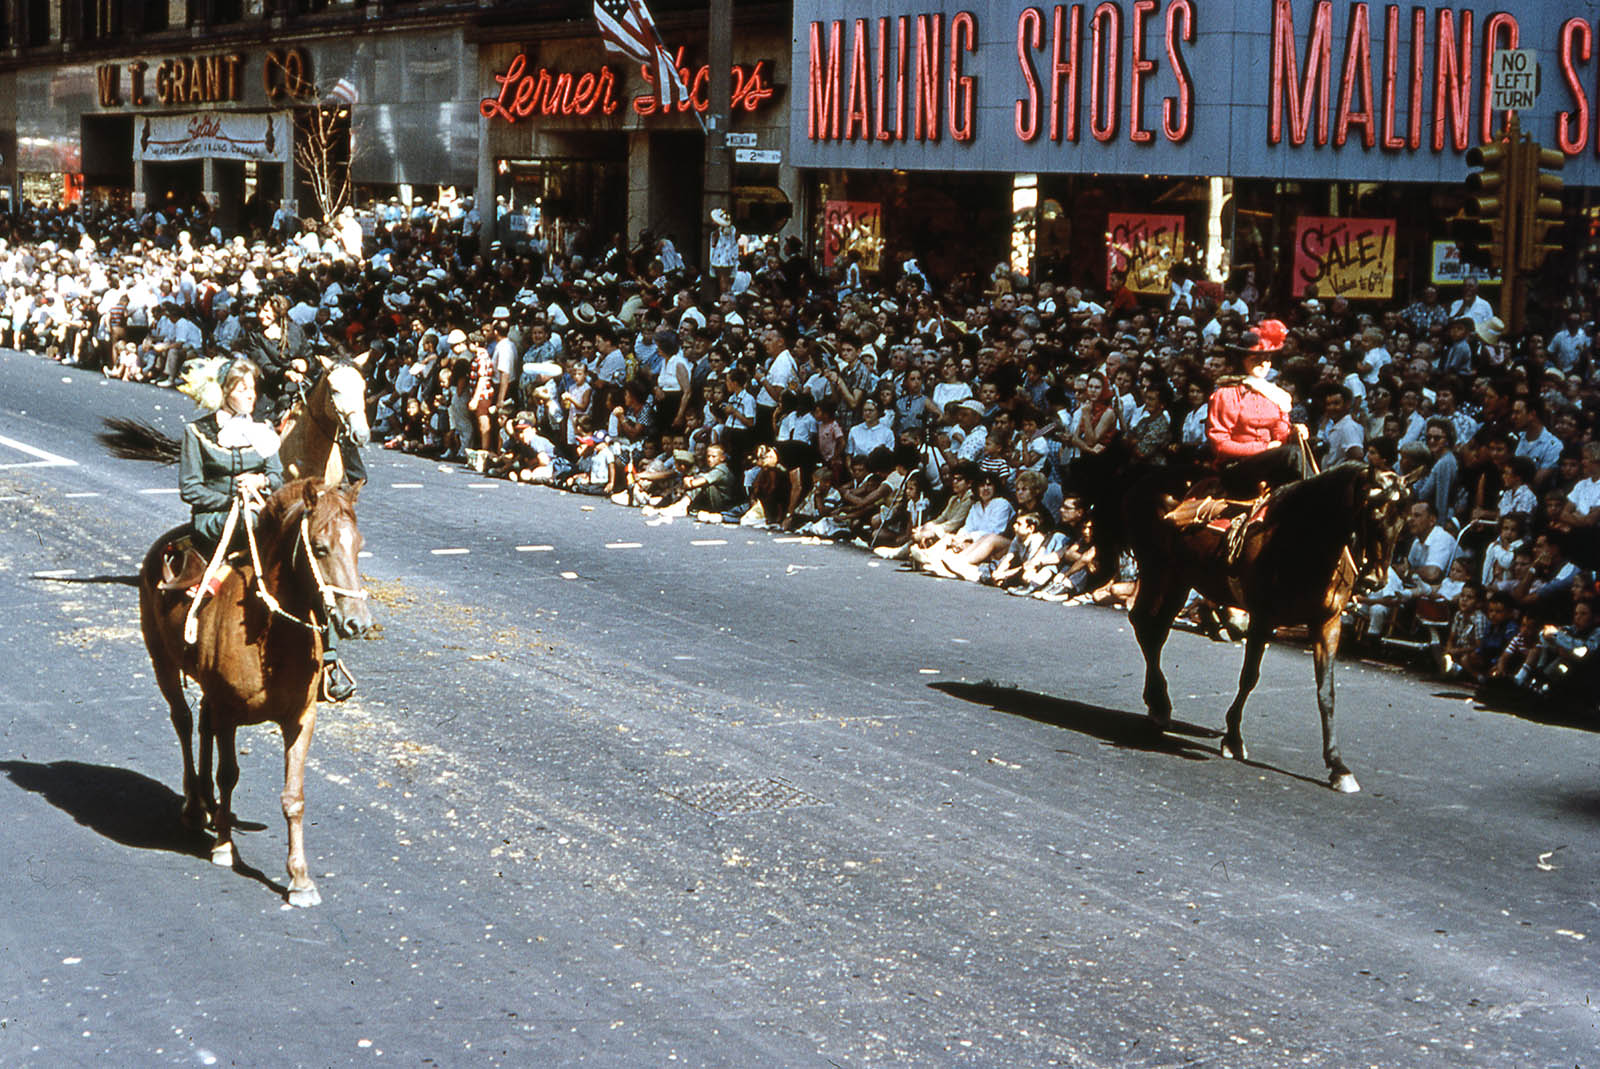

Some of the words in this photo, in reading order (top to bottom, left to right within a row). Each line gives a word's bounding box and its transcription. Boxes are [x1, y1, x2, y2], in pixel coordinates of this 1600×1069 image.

[156, 55, 241, 103] GRANT
[807, 11, 975, 141] MALING
[1015, 0, 1192, 141] SHOES
[1560, 17, 1600, 155] S
[1495, 73, 1532, 89] LEFT
[1502, 53, 1527, 72] NO
[480, 54, 616, 123] Lerner
[1495, 91, 1533, 107] TURN
[1301, 224, 1390, 283] SALE!
